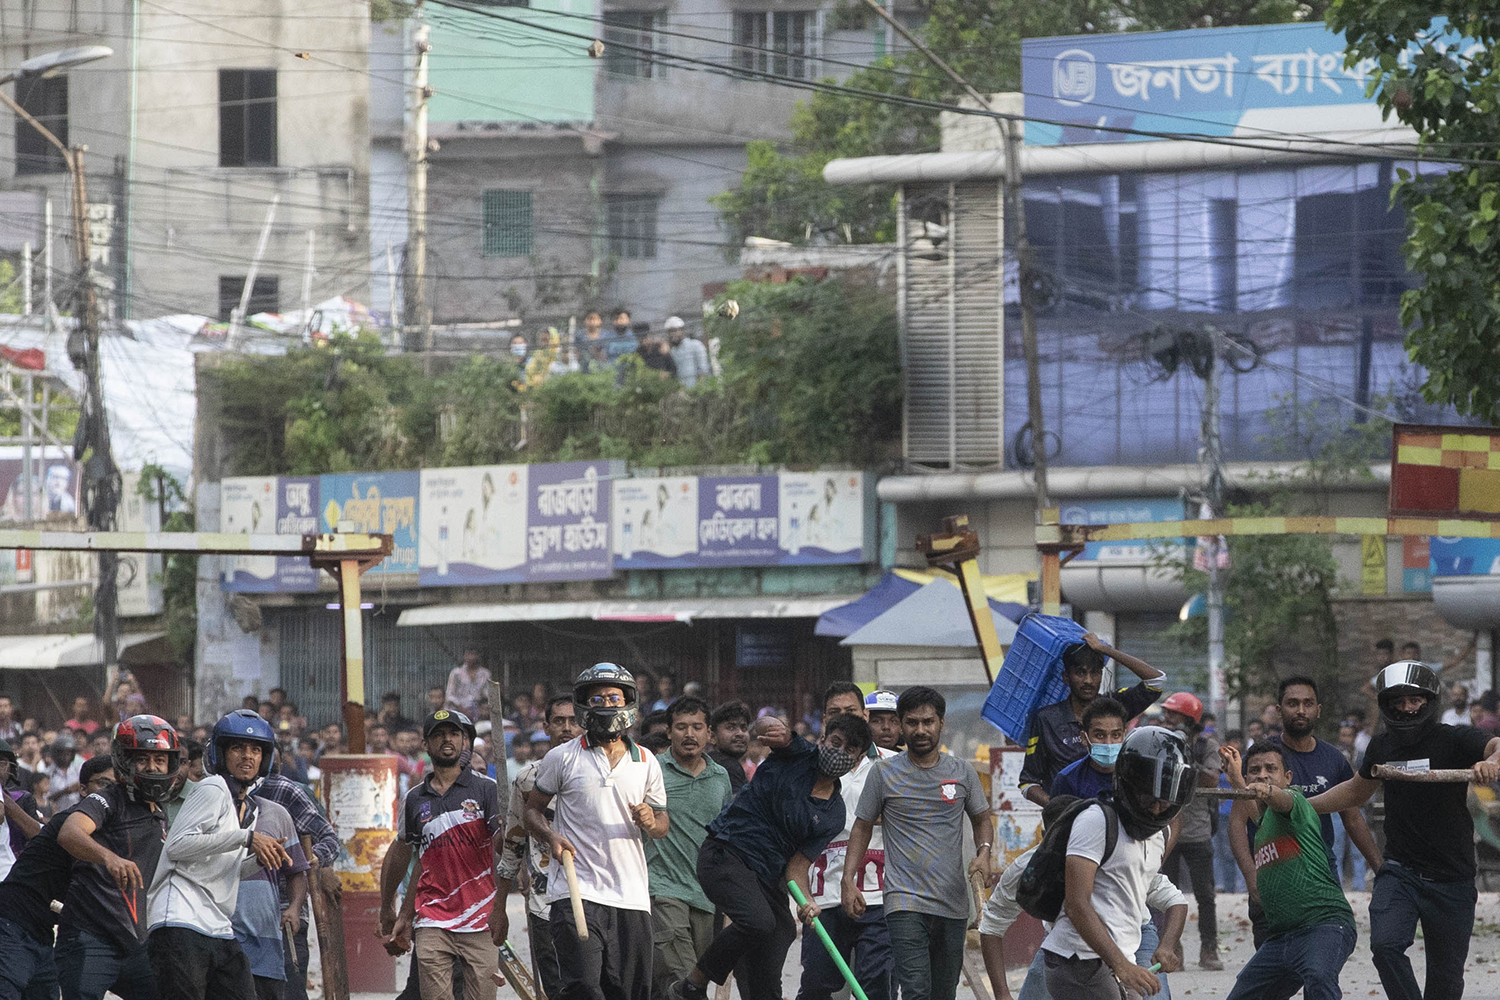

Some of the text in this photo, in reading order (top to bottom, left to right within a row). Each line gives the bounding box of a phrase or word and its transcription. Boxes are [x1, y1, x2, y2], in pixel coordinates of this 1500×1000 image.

[1107, 52, 1239, 100] জনতা
[1252, 47, 1378, 95] ব্যাংক
[537, 465, 598, 517] রাজবাড়ী
[528, 515, 608, 559] ড্রাগ হাউস
[700, 510, 778, 546] মেডিকেল হল
